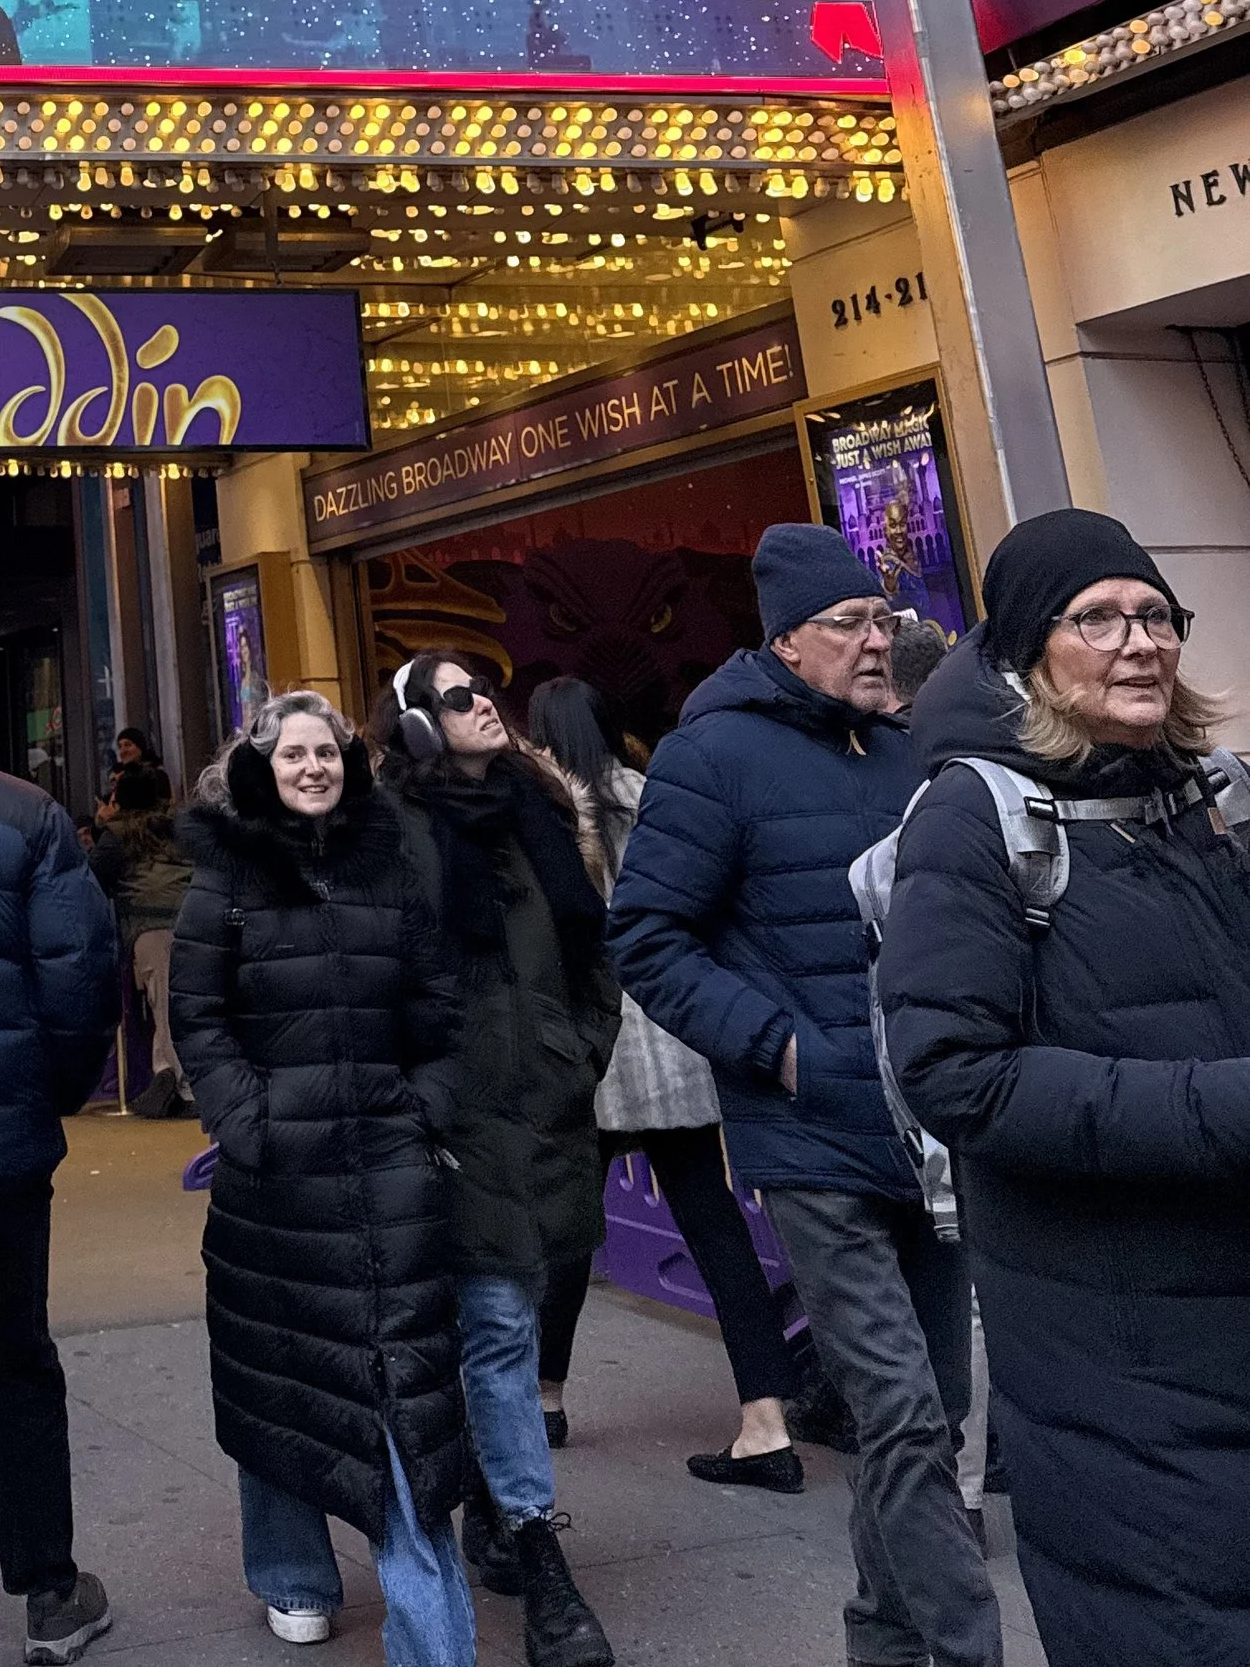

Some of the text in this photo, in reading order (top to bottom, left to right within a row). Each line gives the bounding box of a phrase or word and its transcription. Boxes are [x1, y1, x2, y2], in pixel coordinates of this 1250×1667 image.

[313, 343, 795, 523] DAZZLING BROADWAY ONE WISH AT A TIME!
[831, 422, 891, 453] BROADWAY
[835, 449, 860, 470] JUST
[871, 439, 902, 460] WISH
